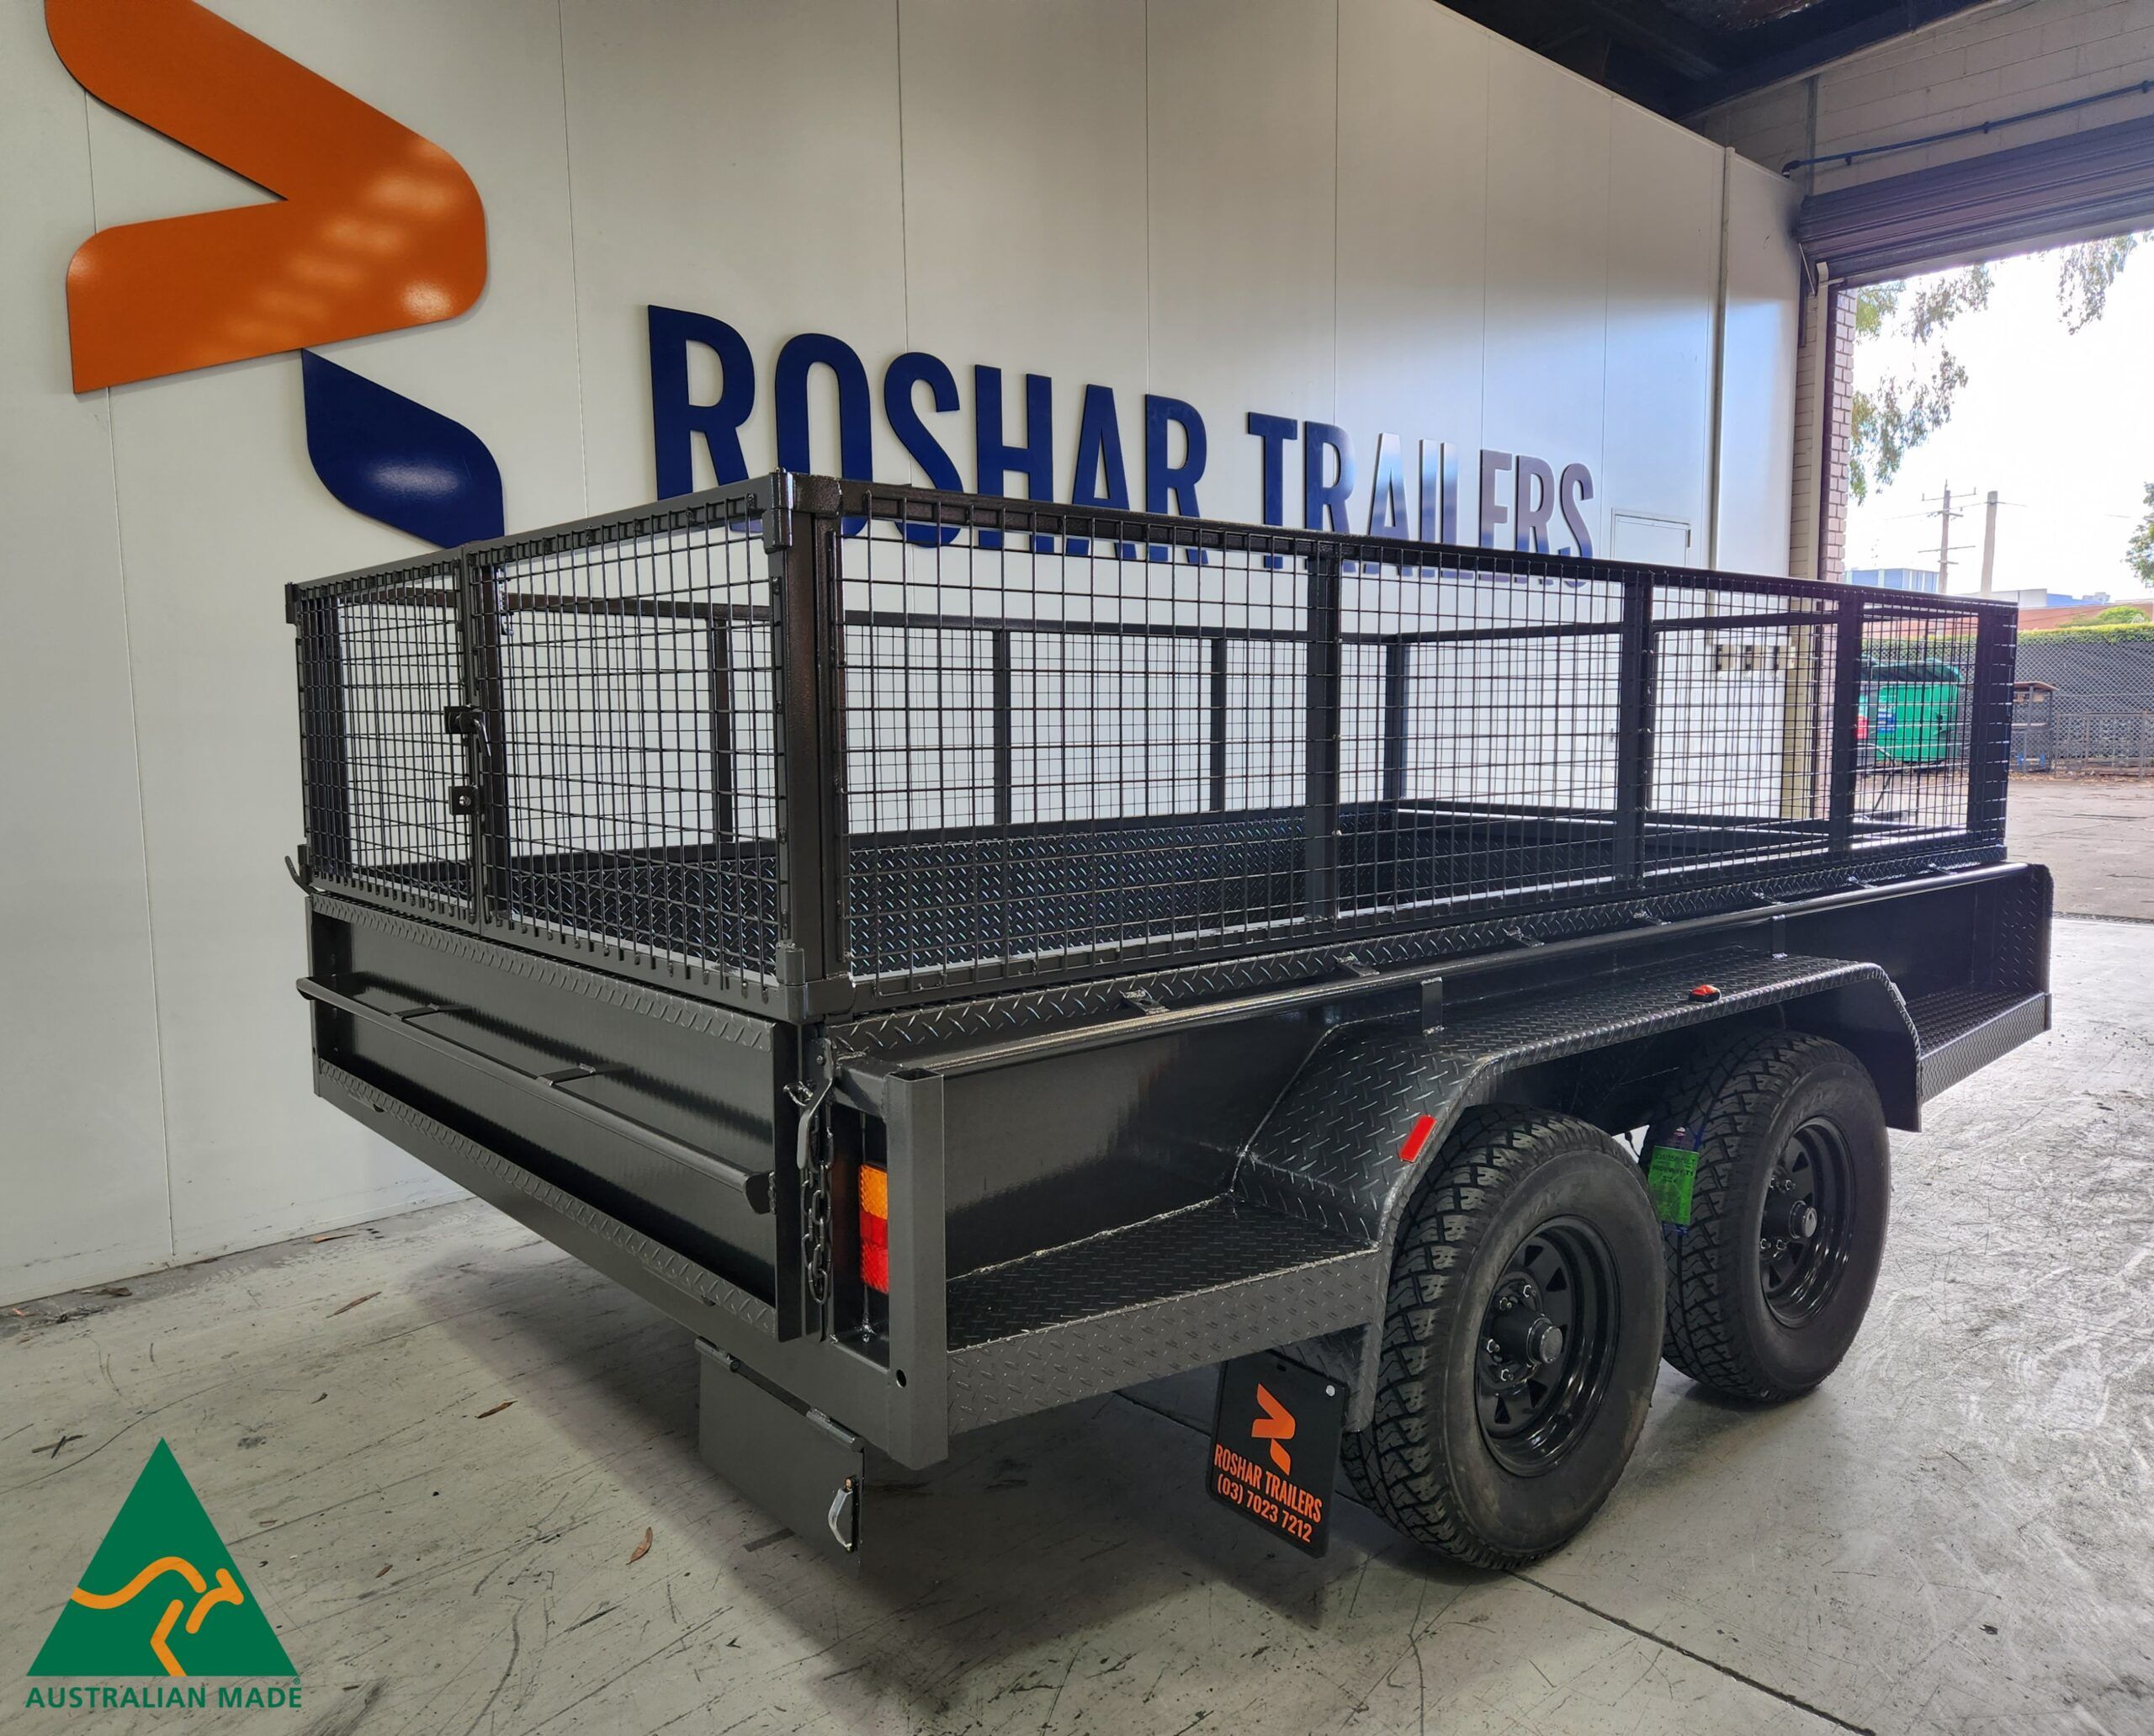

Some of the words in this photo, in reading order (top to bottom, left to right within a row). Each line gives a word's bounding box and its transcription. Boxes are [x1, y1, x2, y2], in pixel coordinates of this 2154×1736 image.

[647, 304, 1208, 565] ROSHAR
[1247, 411, 1594, 589] TRAILERS
[1214, 1443, 1263, 1489] ROSHAR
[1265, 1471, 1323, 1522] TRAILERS
[1218, 1473, 1244, 1504] (03)
[1247, 1490, 1278, 1522] 7023
[1282, 1510, 1313, 1542] 7212
